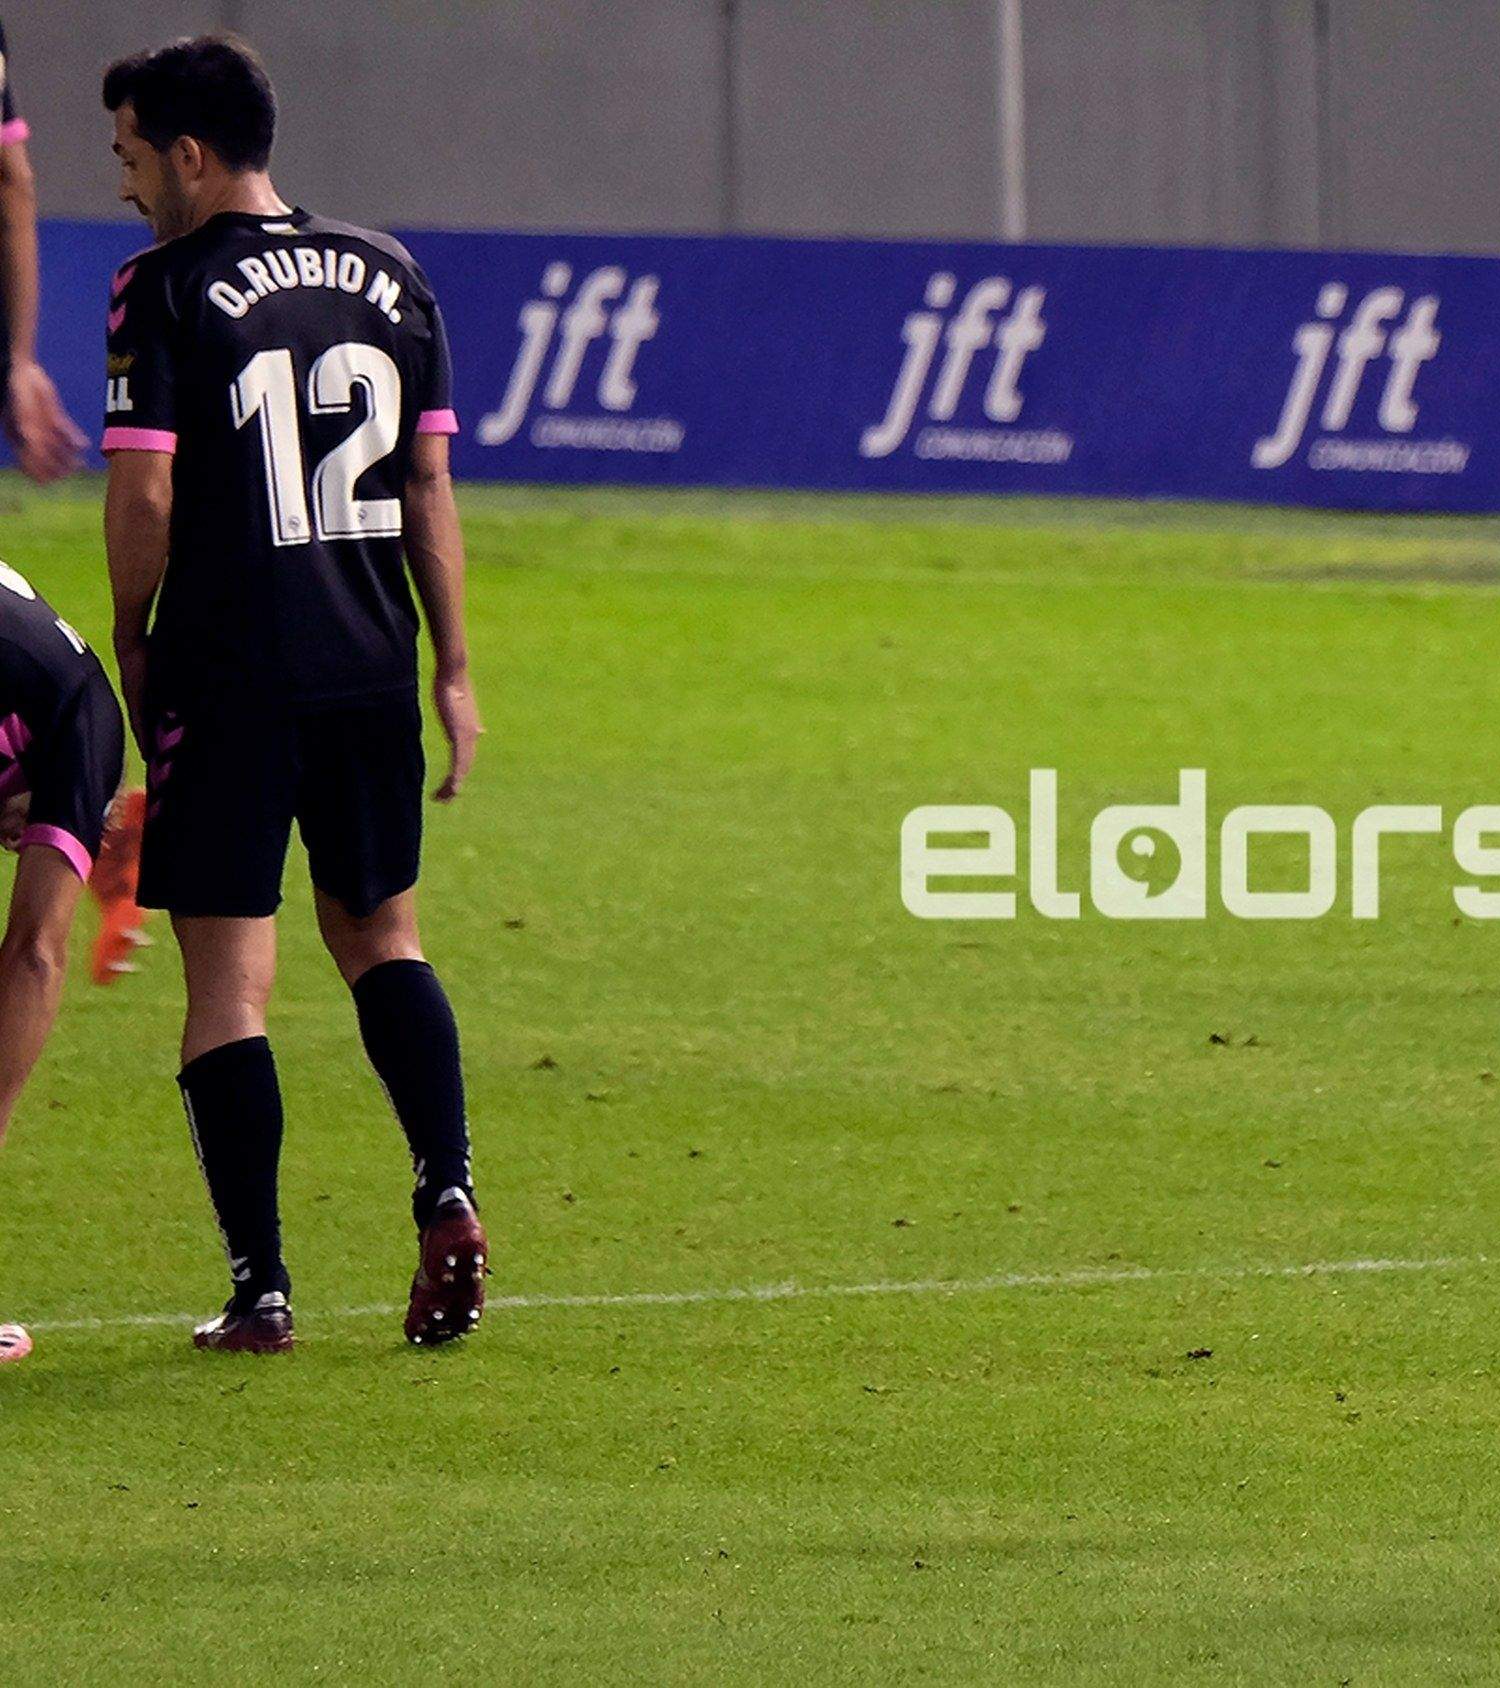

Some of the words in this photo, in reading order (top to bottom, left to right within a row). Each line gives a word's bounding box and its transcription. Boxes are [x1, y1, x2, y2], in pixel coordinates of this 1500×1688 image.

[207, 247, 366, 319] O.RUBIO
[365, 269, 401, 324] N.
[476, 261, 662, 446] jft
[858, 269, 1048, 459] jft
[1251, 281, 1442, 469] jft
[229, 342, 402, 546] 12
